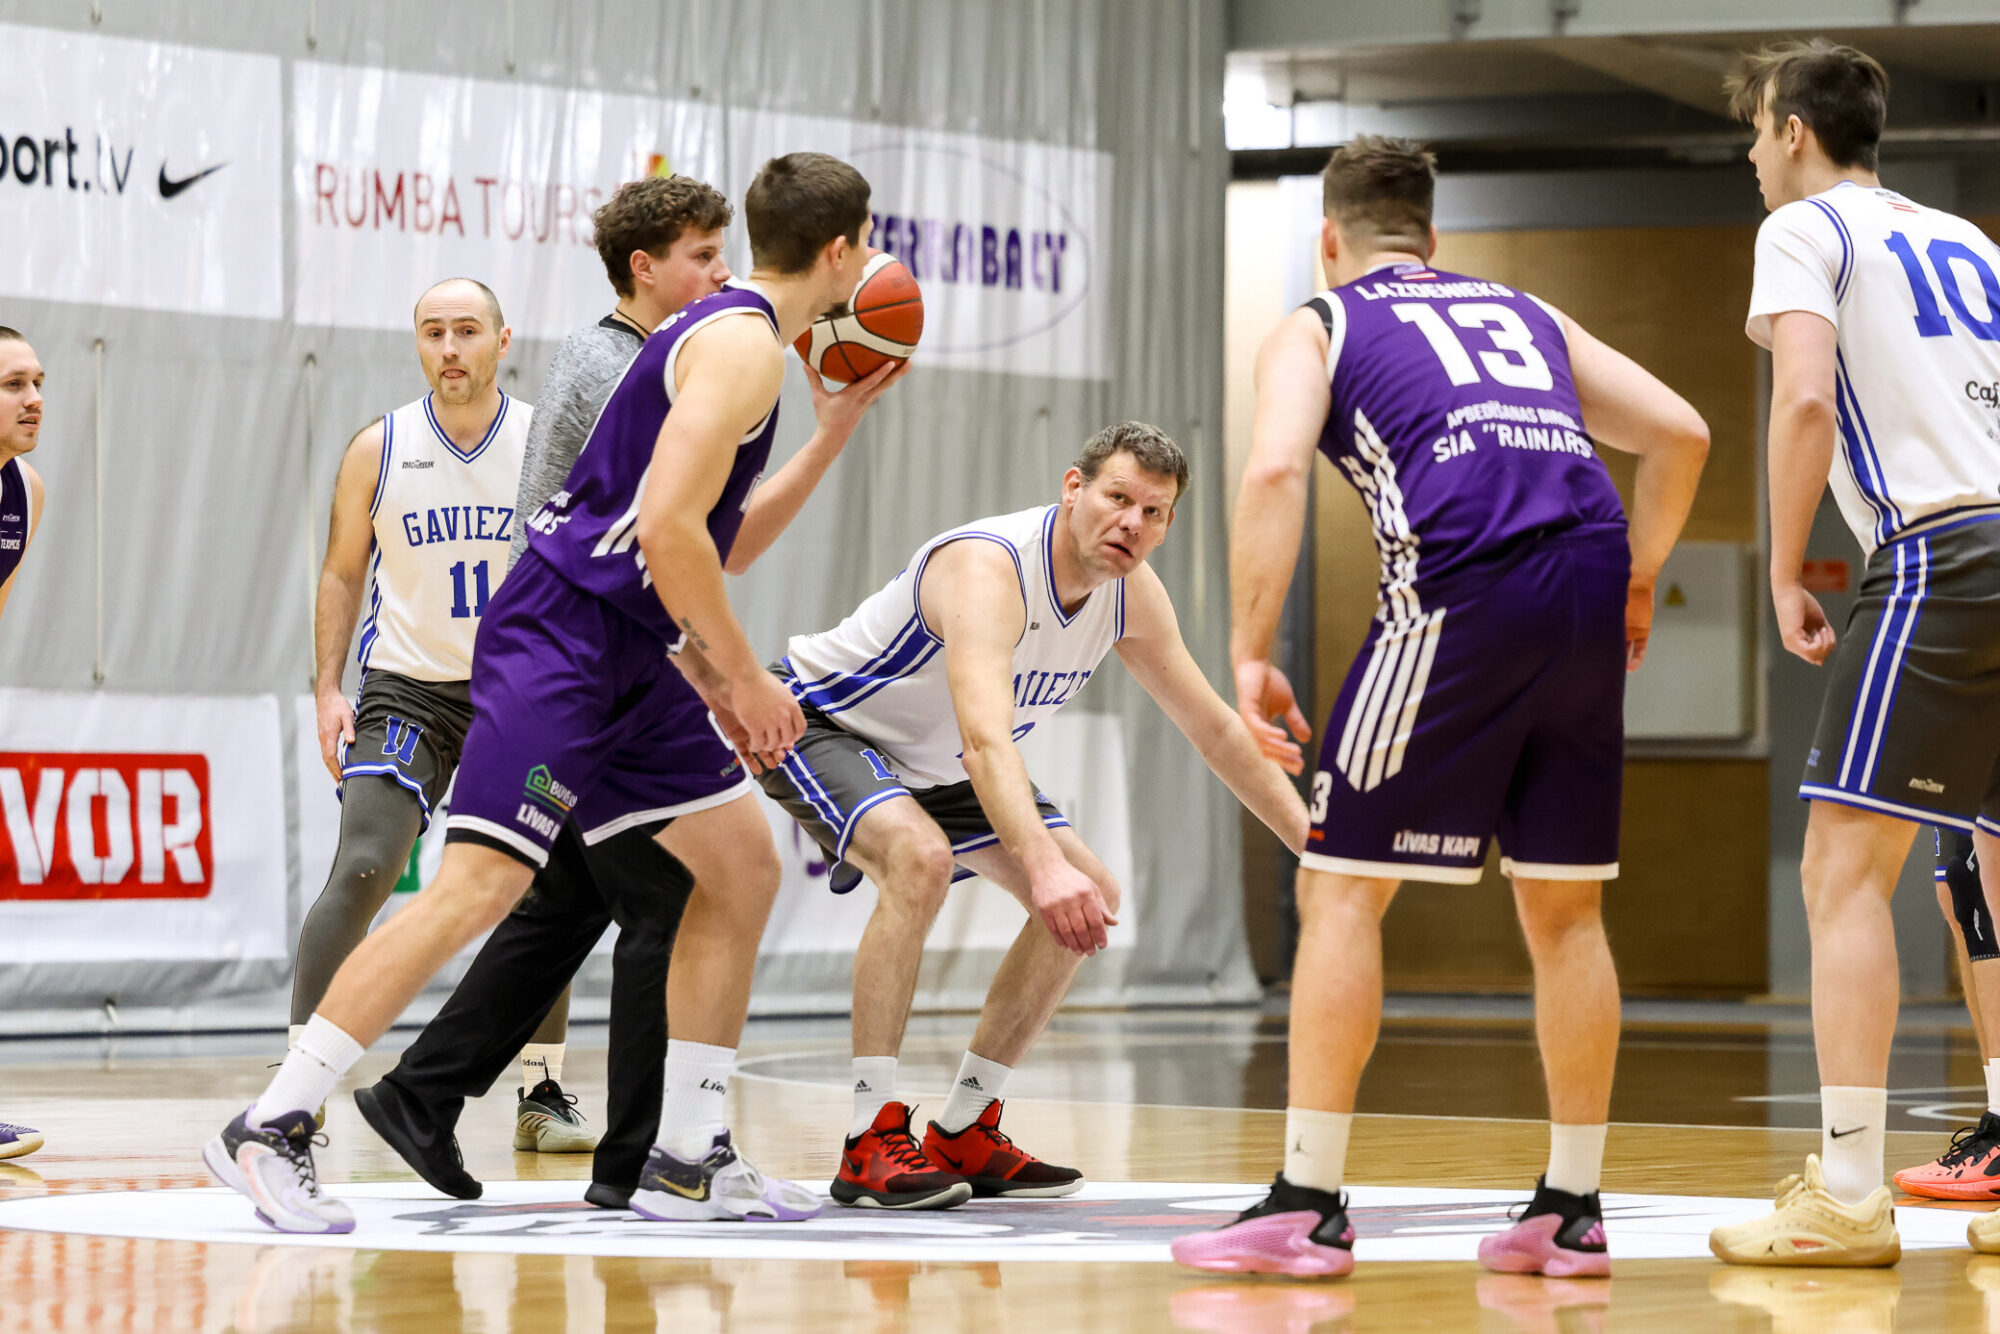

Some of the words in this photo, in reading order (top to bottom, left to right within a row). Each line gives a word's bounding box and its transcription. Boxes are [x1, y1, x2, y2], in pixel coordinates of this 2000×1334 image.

[315, 164, 465, 238] RUMBA
[474, 175, 602, 247] TOURS
[1884, 230, 2000, 342] 10
[1390, 302, 1553, 391] 13
[1432, 429, 1477, 463] SIA
[449, 560, 491, 618] 11
[381, 714, 424, 766] 11
[0, 767, 205, 885] VOR
